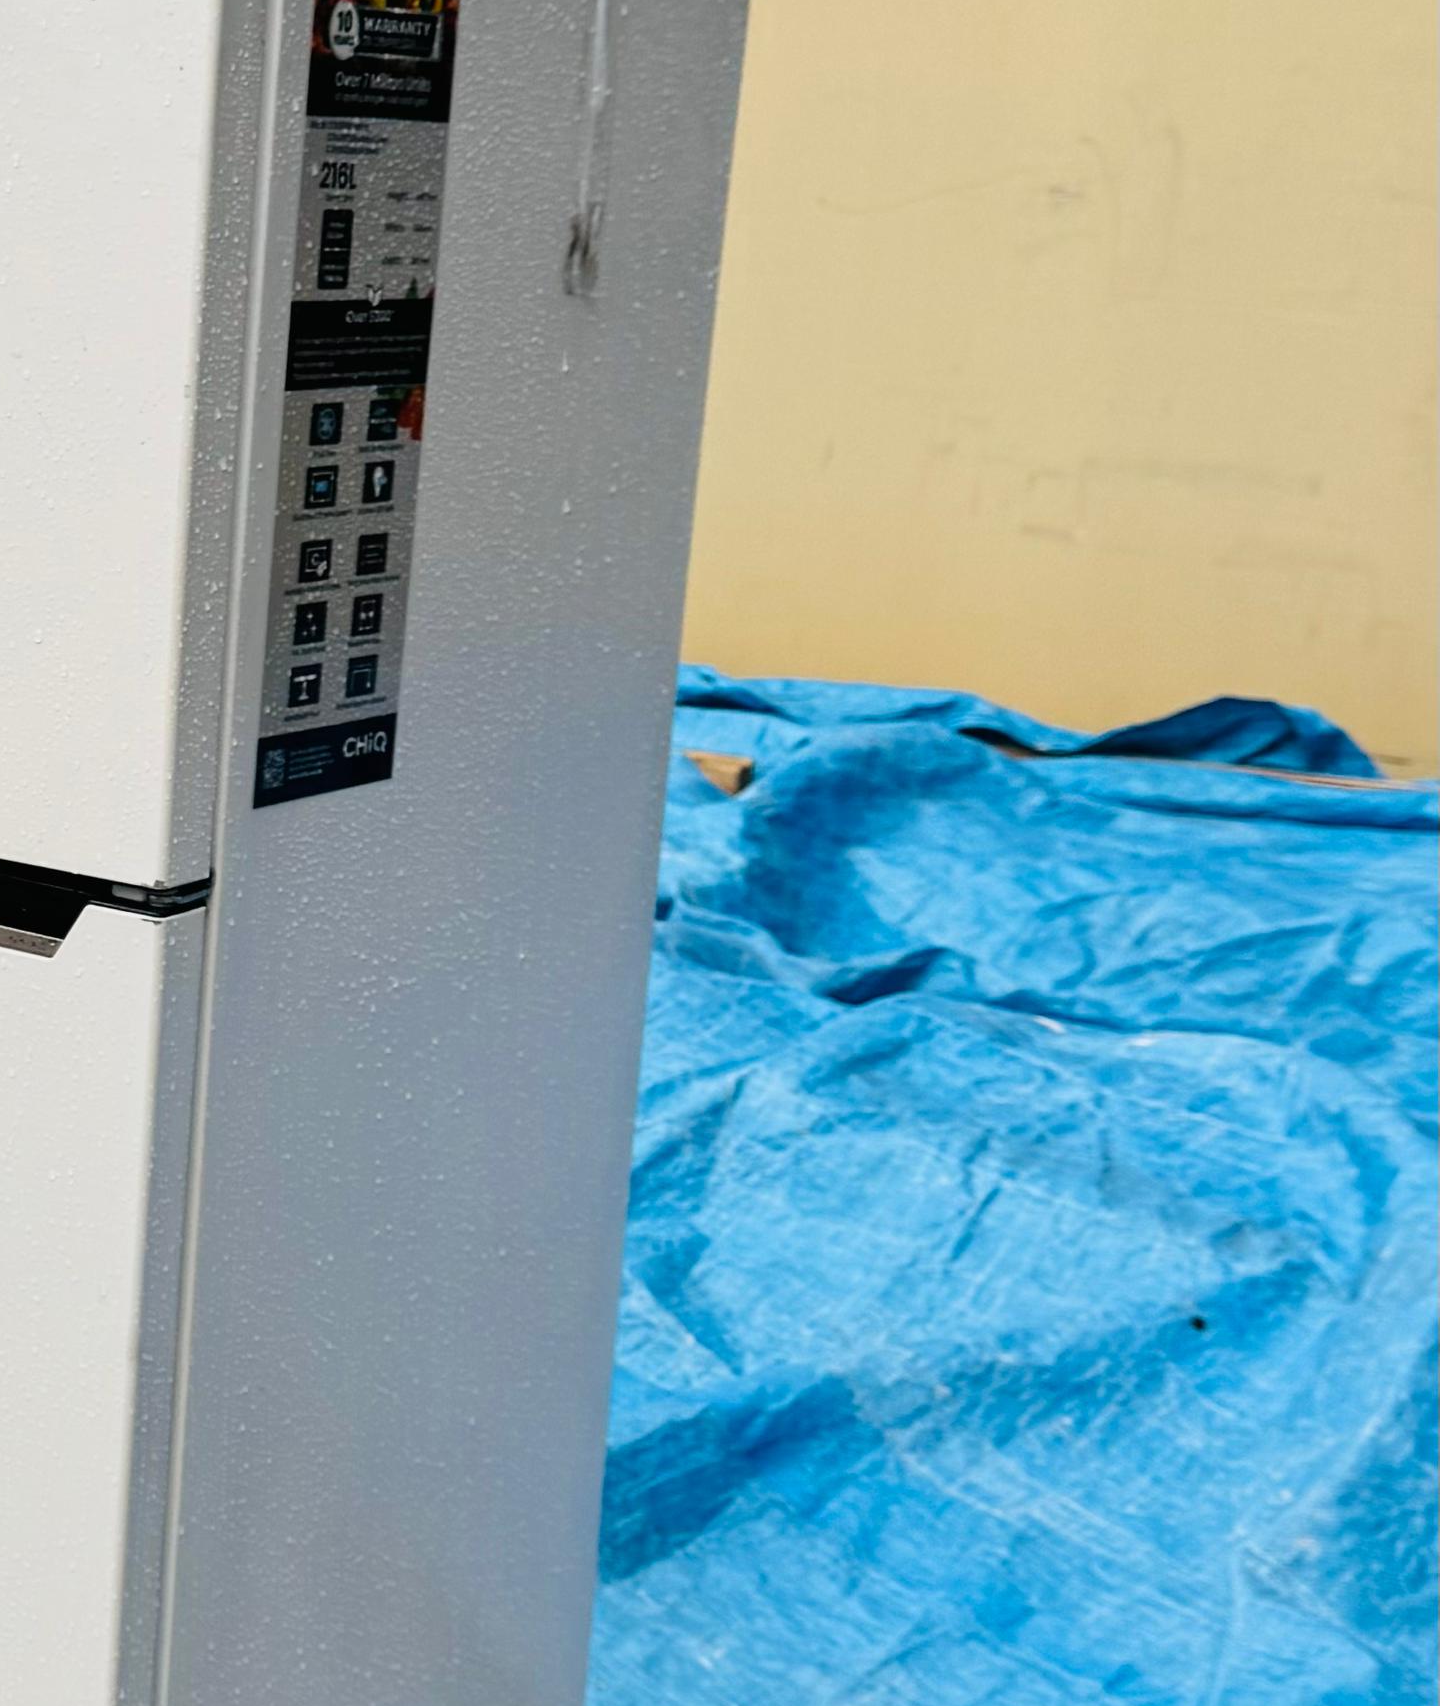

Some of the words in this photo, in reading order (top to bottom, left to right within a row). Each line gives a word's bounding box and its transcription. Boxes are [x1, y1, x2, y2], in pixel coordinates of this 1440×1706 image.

[336, 9, 353, 33] 10
[363, 17, 432, 35] WARRANTY
[319, 161, 357, 190] 216L
[342, 731, 387, 758] CHiQ
